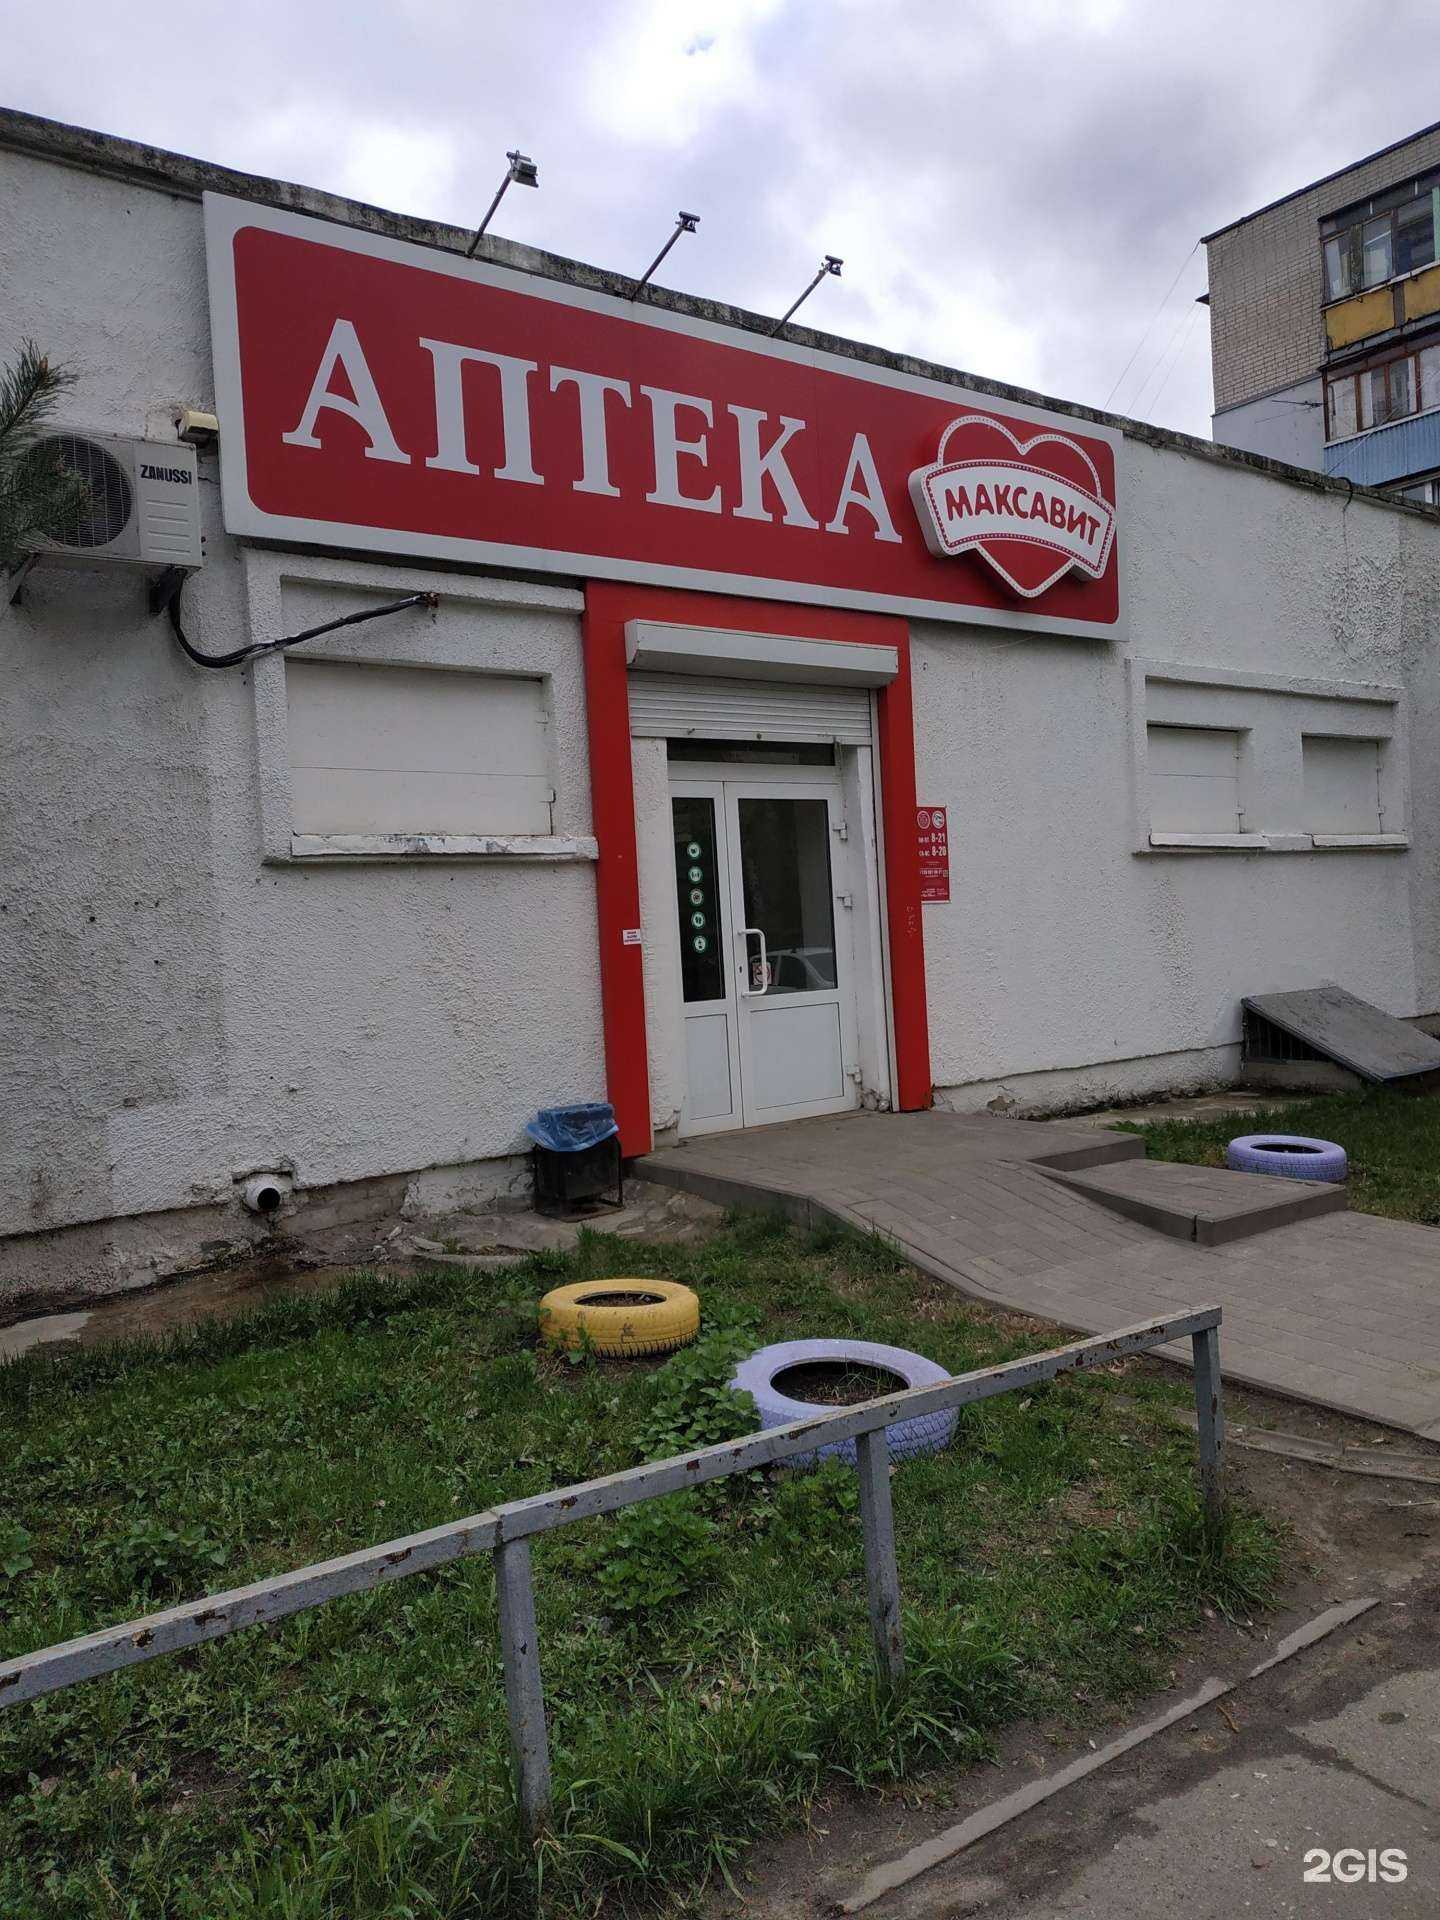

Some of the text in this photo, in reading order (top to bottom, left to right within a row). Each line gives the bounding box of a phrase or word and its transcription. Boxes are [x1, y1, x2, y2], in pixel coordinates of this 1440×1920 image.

[282, 318, 903, 544] АПТЕКА
[140, 464, 192, 485] ZANUSSI
[945, 483, 1101, 546] МАКСАВИТ
